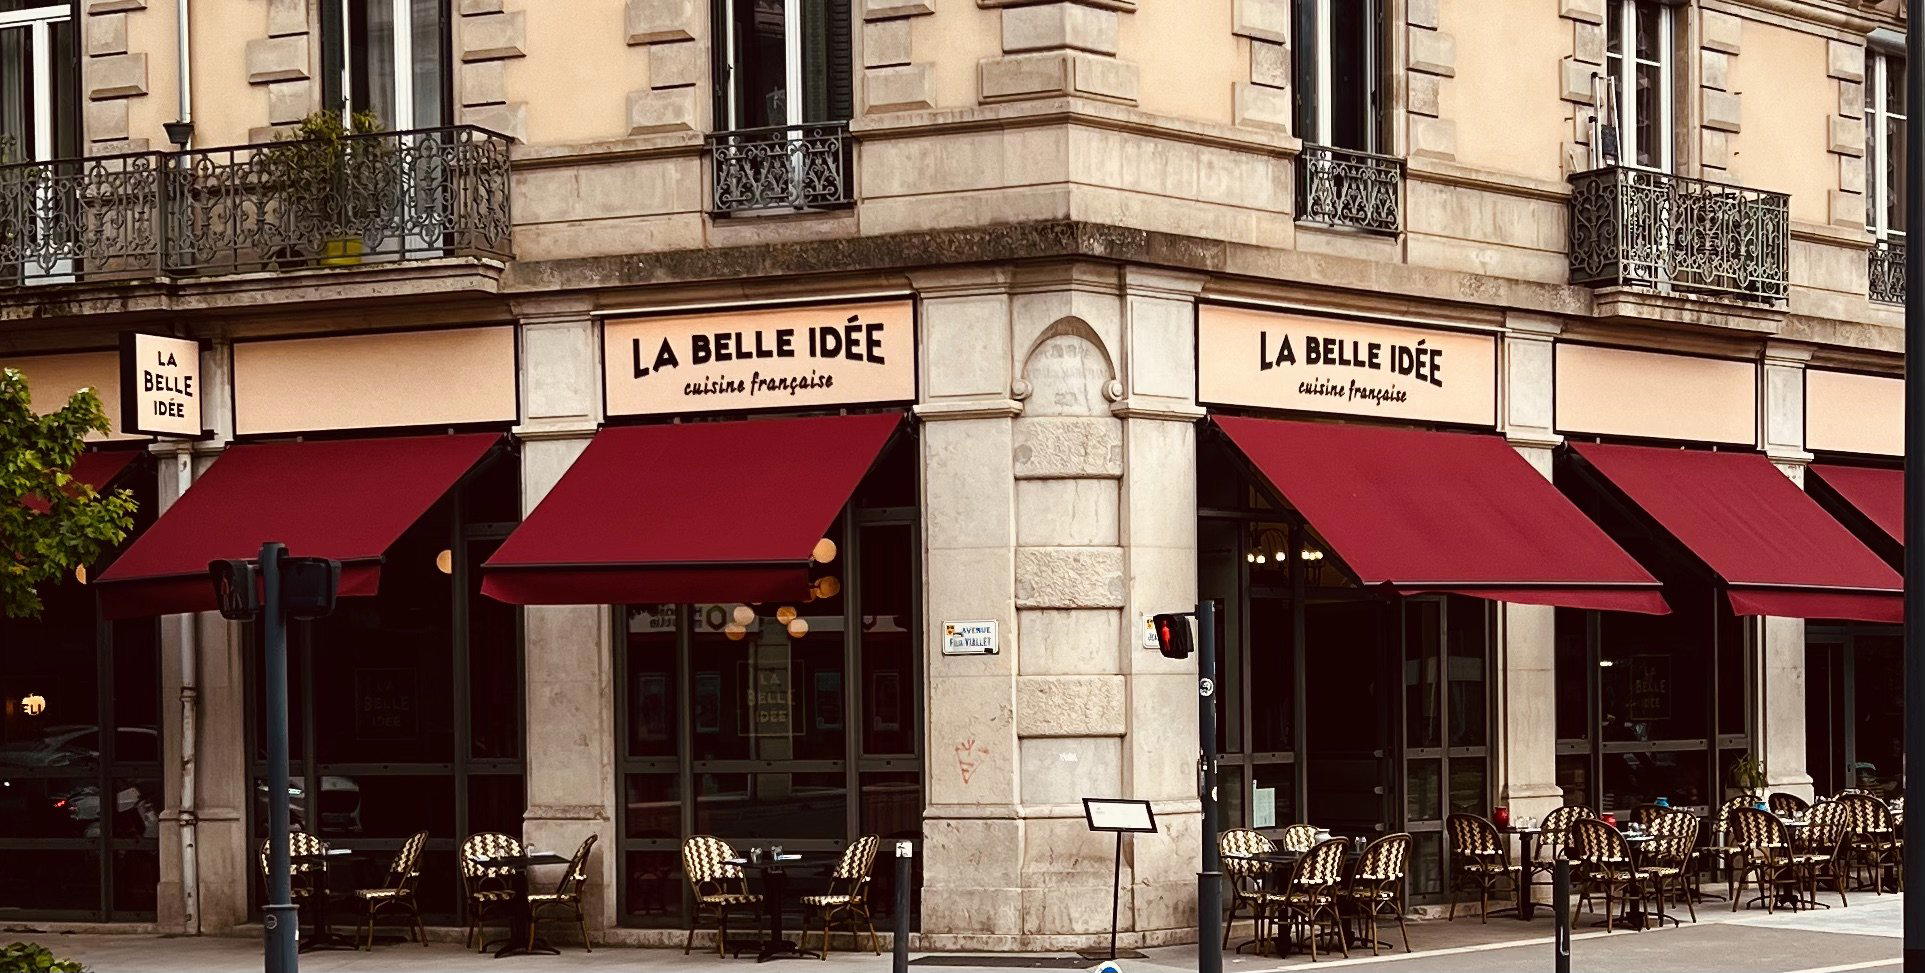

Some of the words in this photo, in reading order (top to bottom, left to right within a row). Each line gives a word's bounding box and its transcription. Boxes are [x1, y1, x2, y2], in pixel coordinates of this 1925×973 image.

[157, 350, 178, 368] LA
[633, 337, 679, 379] LA
[691, 329, 795, 365] BELLE
[808, 315, 885, 365] IDÉE
[1260, 331, 1297, 371] LA
[1305, 336, 1381, 370] BELLE
[1390, 339, 1442, 388] IDÉE
[144, 369, 193, 397] BELLE
[683, 375, 746, 396] cuisine
[750, 369, 834, 396] française
[1298, 377, 1345, 398] cuisine
[1348, 379, 1407, 406] française
[153, 398, 185, 418] IDÉE
[961, 626, 992, 634] AVENUE
[759, 673, 781, 685] LA
